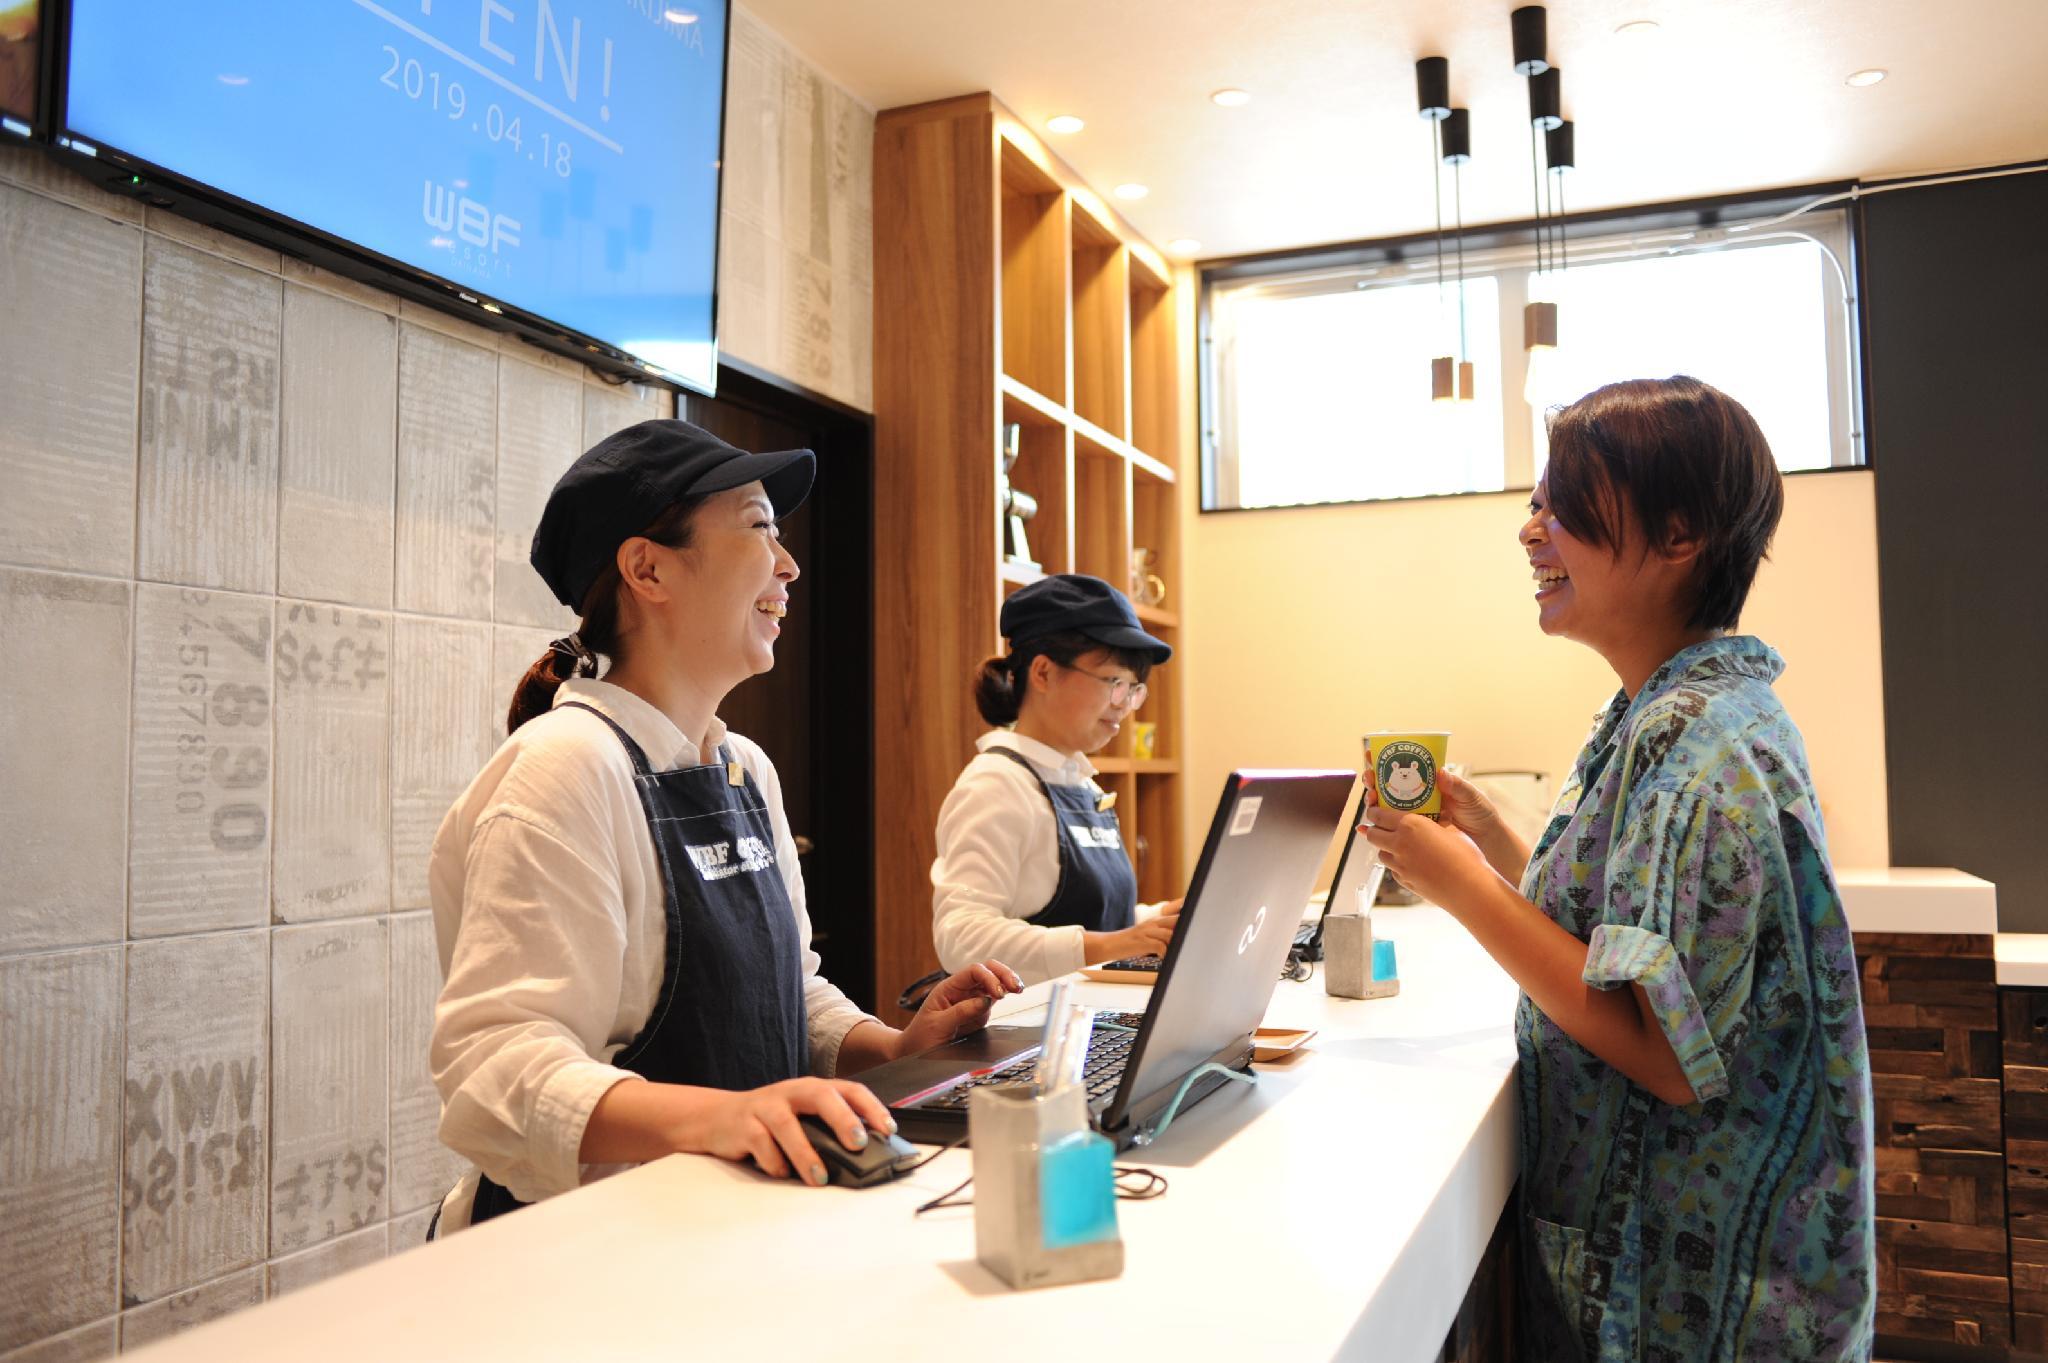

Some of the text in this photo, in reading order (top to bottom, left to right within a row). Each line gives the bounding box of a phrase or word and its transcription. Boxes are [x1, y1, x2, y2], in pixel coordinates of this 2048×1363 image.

[379, 45, 572, 178] 2019.04.18
[421, 0, 613, 123] EN!
[423, 180, 522, 254] WBF
